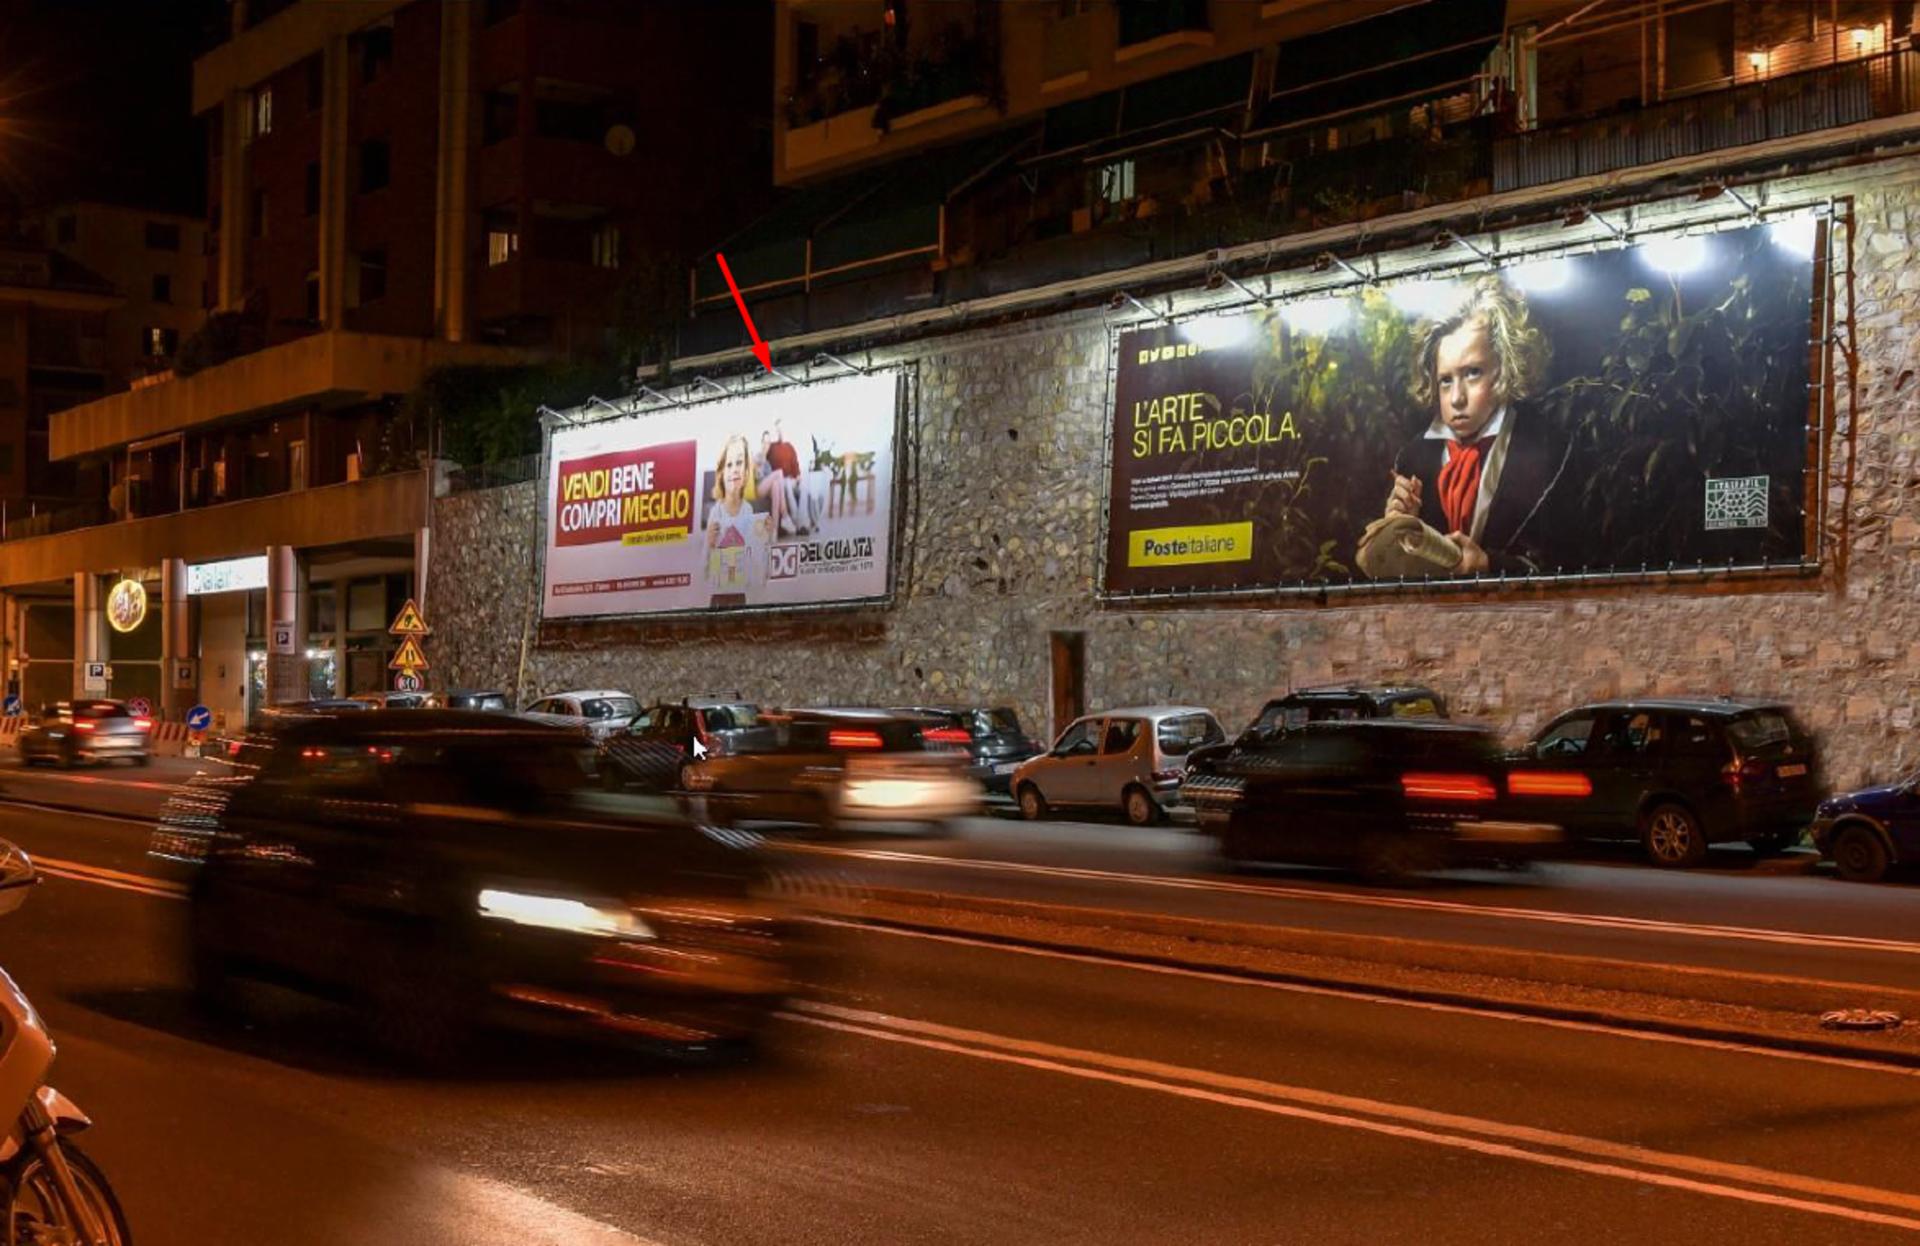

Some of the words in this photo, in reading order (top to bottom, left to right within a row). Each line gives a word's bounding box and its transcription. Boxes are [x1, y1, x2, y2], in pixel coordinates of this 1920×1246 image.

[1134, 392, 1205, 428] L'ARTE
[1133, 429, 1151, 458] SI
[1158, 426, 1187, 454] FA
[1192, 411, 1302, 451] PICCOLA.
[562, 469, 611, 502] VENDI
[611, 461, 655, 494] BENE
[560, 497, 622, 532] COMPRI
[622, 488, 690, 525] MEGLIO
[800, 541, 822, 563] DEL
[824, 537, 874, 560] GUASTA
[92, 665, 102, 676] P
